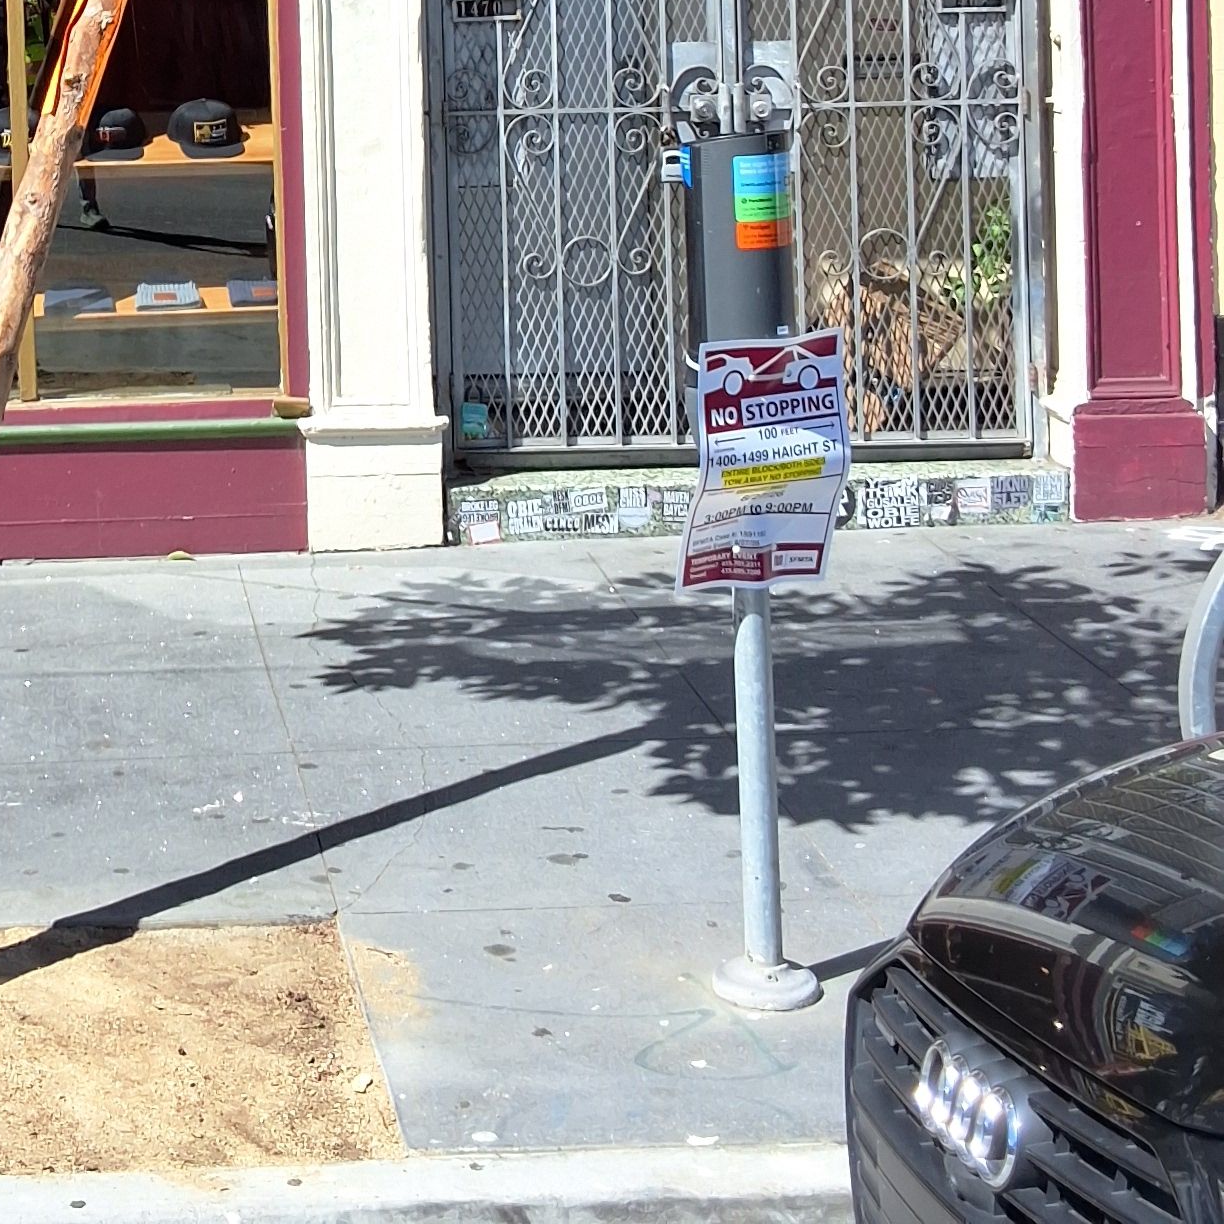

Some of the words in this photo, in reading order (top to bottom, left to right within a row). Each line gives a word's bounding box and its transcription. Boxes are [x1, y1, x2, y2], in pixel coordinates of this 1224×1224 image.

[458, 0, 501, 17] 1470
[710, 406, 738, 427] NO
[745, 392, 835, 421] STOPPING
[758, 427, 778, 441] 100
[780, 426, 800, 437] FEET
[710, 450, 769, 468] 1400-1499
[772, 441, 819, 459] HAIGHT
[822, 439, 839, 454] ST
[866, 485, 918, 499] THINK
[866, 496, 919, 509] GUSALEN
[704, 504, 747, 525] 3:00PM
[749, 504, 762, 515] to
[765, 502, 814, 514] 9:00PM
[866, 506, 919, 519] OBIE
[867, 517, 920, 529] WOLFE
